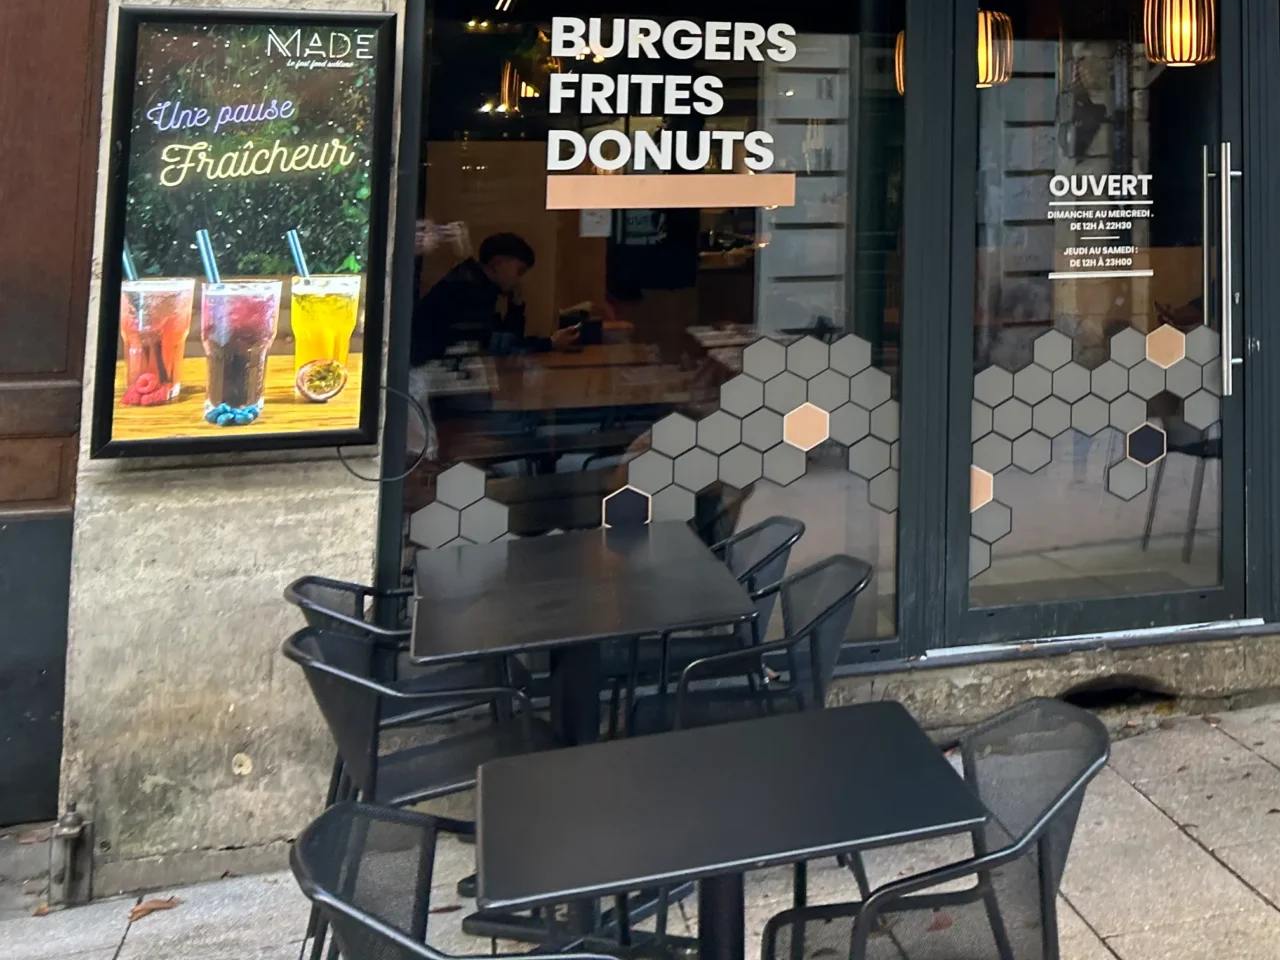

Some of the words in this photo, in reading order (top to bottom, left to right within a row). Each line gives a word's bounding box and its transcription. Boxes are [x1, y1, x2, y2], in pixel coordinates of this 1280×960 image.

[266, 27, 376, 60] MADE
[550, 15, 797, 63] BURGERS
[548, 72, 724, 115] FRITES
[145, 99, 211, 132] Une
[213, 98, 296, 134] pause
[159, 137, 356, 188] Fraîcheur
[546, 128, 775, 171] DONUTS
[1049, 174, 1153, 197] OUVERT
[1047, 210, 1094, 219] DIMANCHE
[1094, 210, 1108, 218] AU
[1108, 209, 1150, 218] MERCREDI
[1070, 222, 1082, 231] DE
[1082, 222, 1097, 230] 12H
[1097, 220, 1105, 230] À
[1105, 221, 1132, 230] 22H30
[1063, 247, 1089, 256] JEUDI
[1088, 246, 1102, 255] AU
[1102, 246, 1134, 255] SAMEDI
[1069, 259, 1082, 268] DE
[1082, 259, 1097, 267] 12H
[1097, 257, 1105, 267] À
[1105, 258, 1133, 267] 23H00
